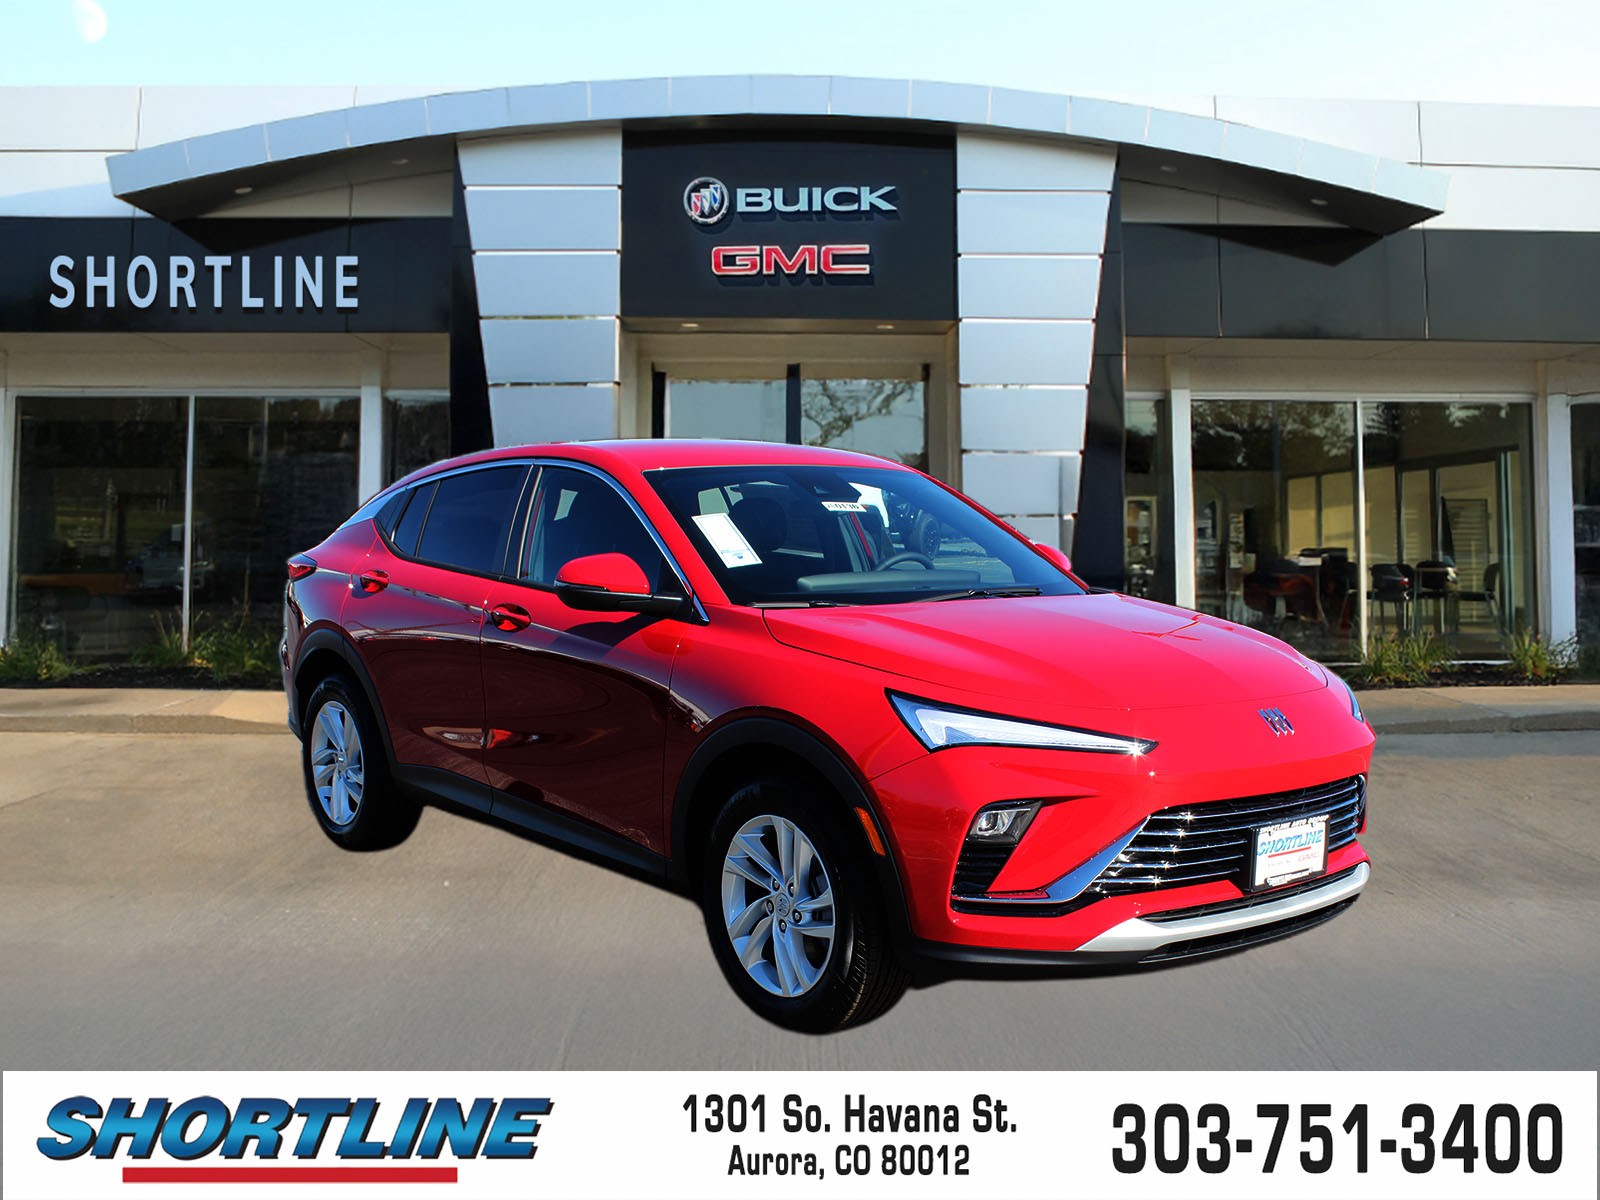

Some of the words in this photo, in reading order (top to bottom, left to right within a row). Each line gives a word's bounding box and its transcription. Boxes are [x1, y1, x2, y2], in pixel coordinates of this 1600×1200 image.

[736, 186, 898, 212] BUICK
[712, 244, 870, 275] GMC
[49, 255, 359, 308] SHORTLINE
[1257, 829, 1323, 856] SHORTLINE
